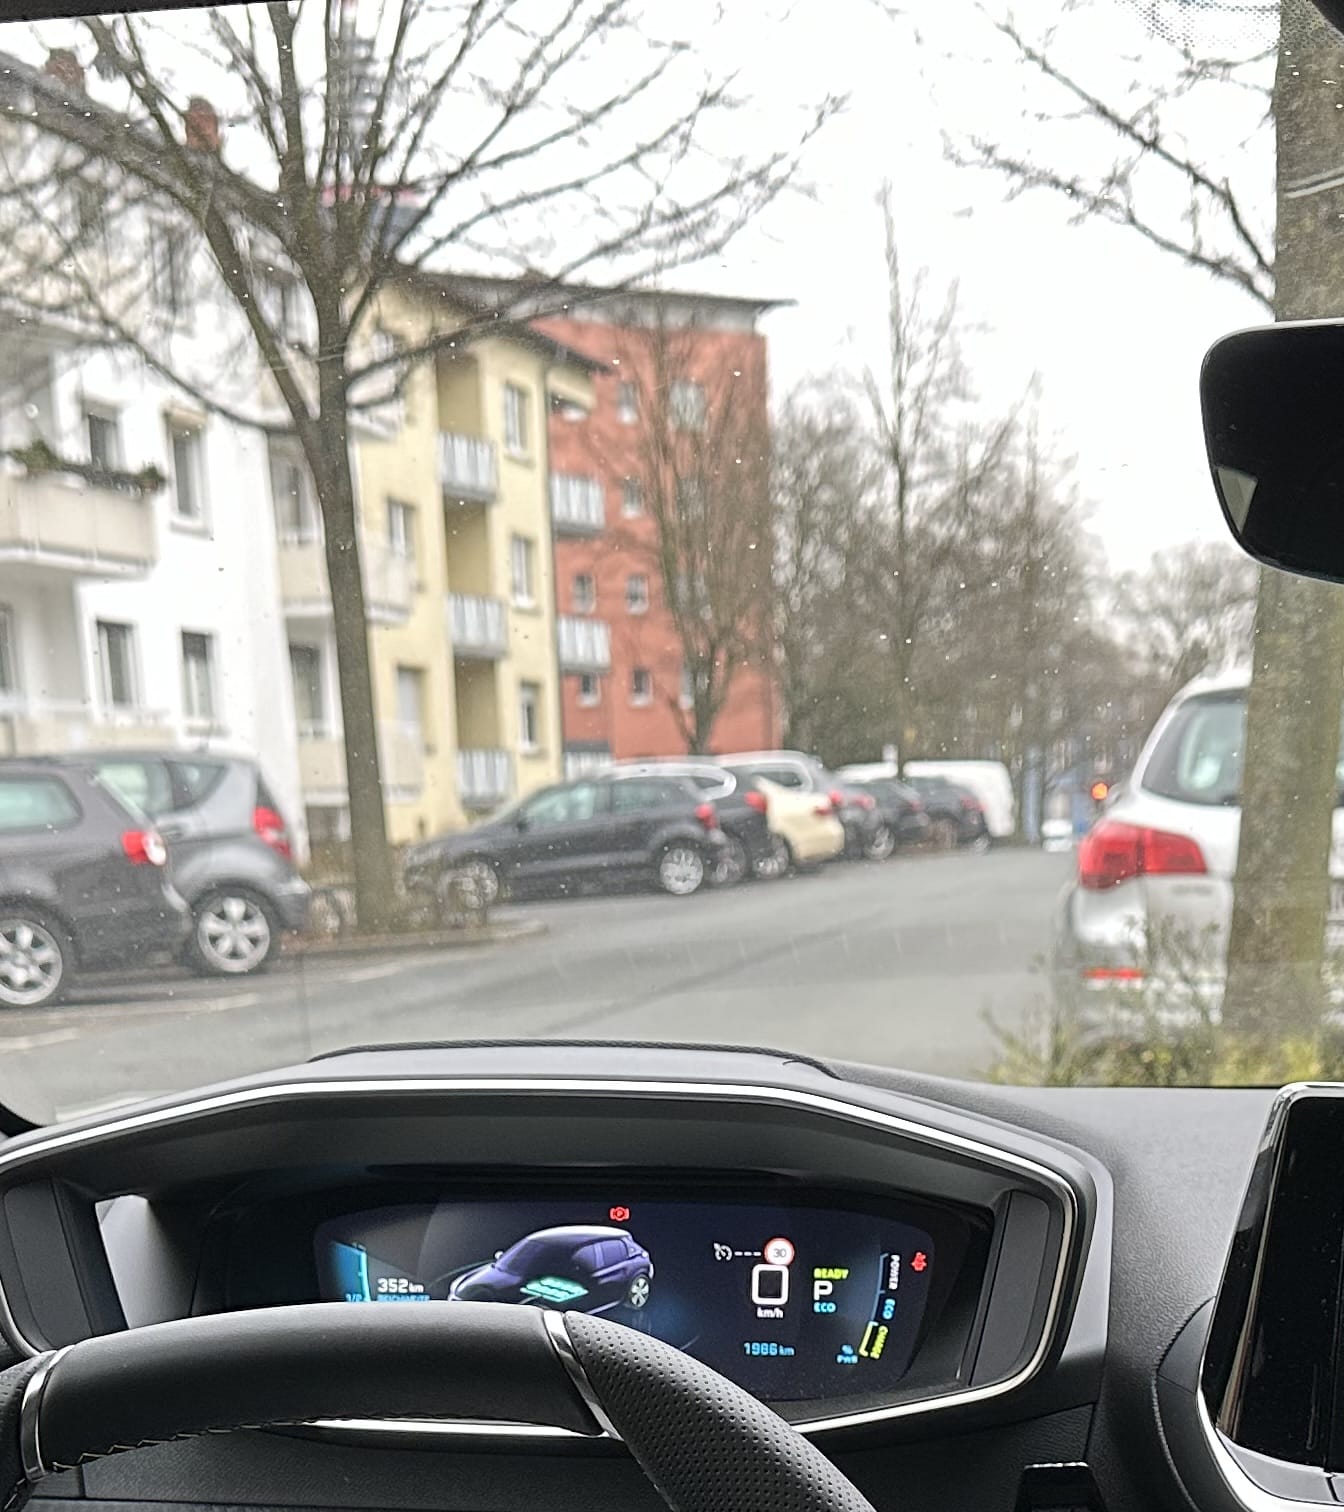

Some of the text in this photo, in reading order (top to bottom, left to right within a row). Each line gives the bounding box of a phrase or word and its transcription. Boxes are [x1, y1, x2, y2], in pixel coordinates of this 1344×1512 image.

[772, 1248, 787, 1258] 30
[813, 1268, 849, 1279] READY
[888, 1254, 901, 1290] POWER
[377, 1278, 425, 1293] 352 km
[813, 1280, 833, 1301] P
[757, 1307, 784, 1319] km/h
[813, 1302, 837, 1313] ECO
[882, 1299, 896, 1320] ECO
[779, 1344, 795, 1356] km
